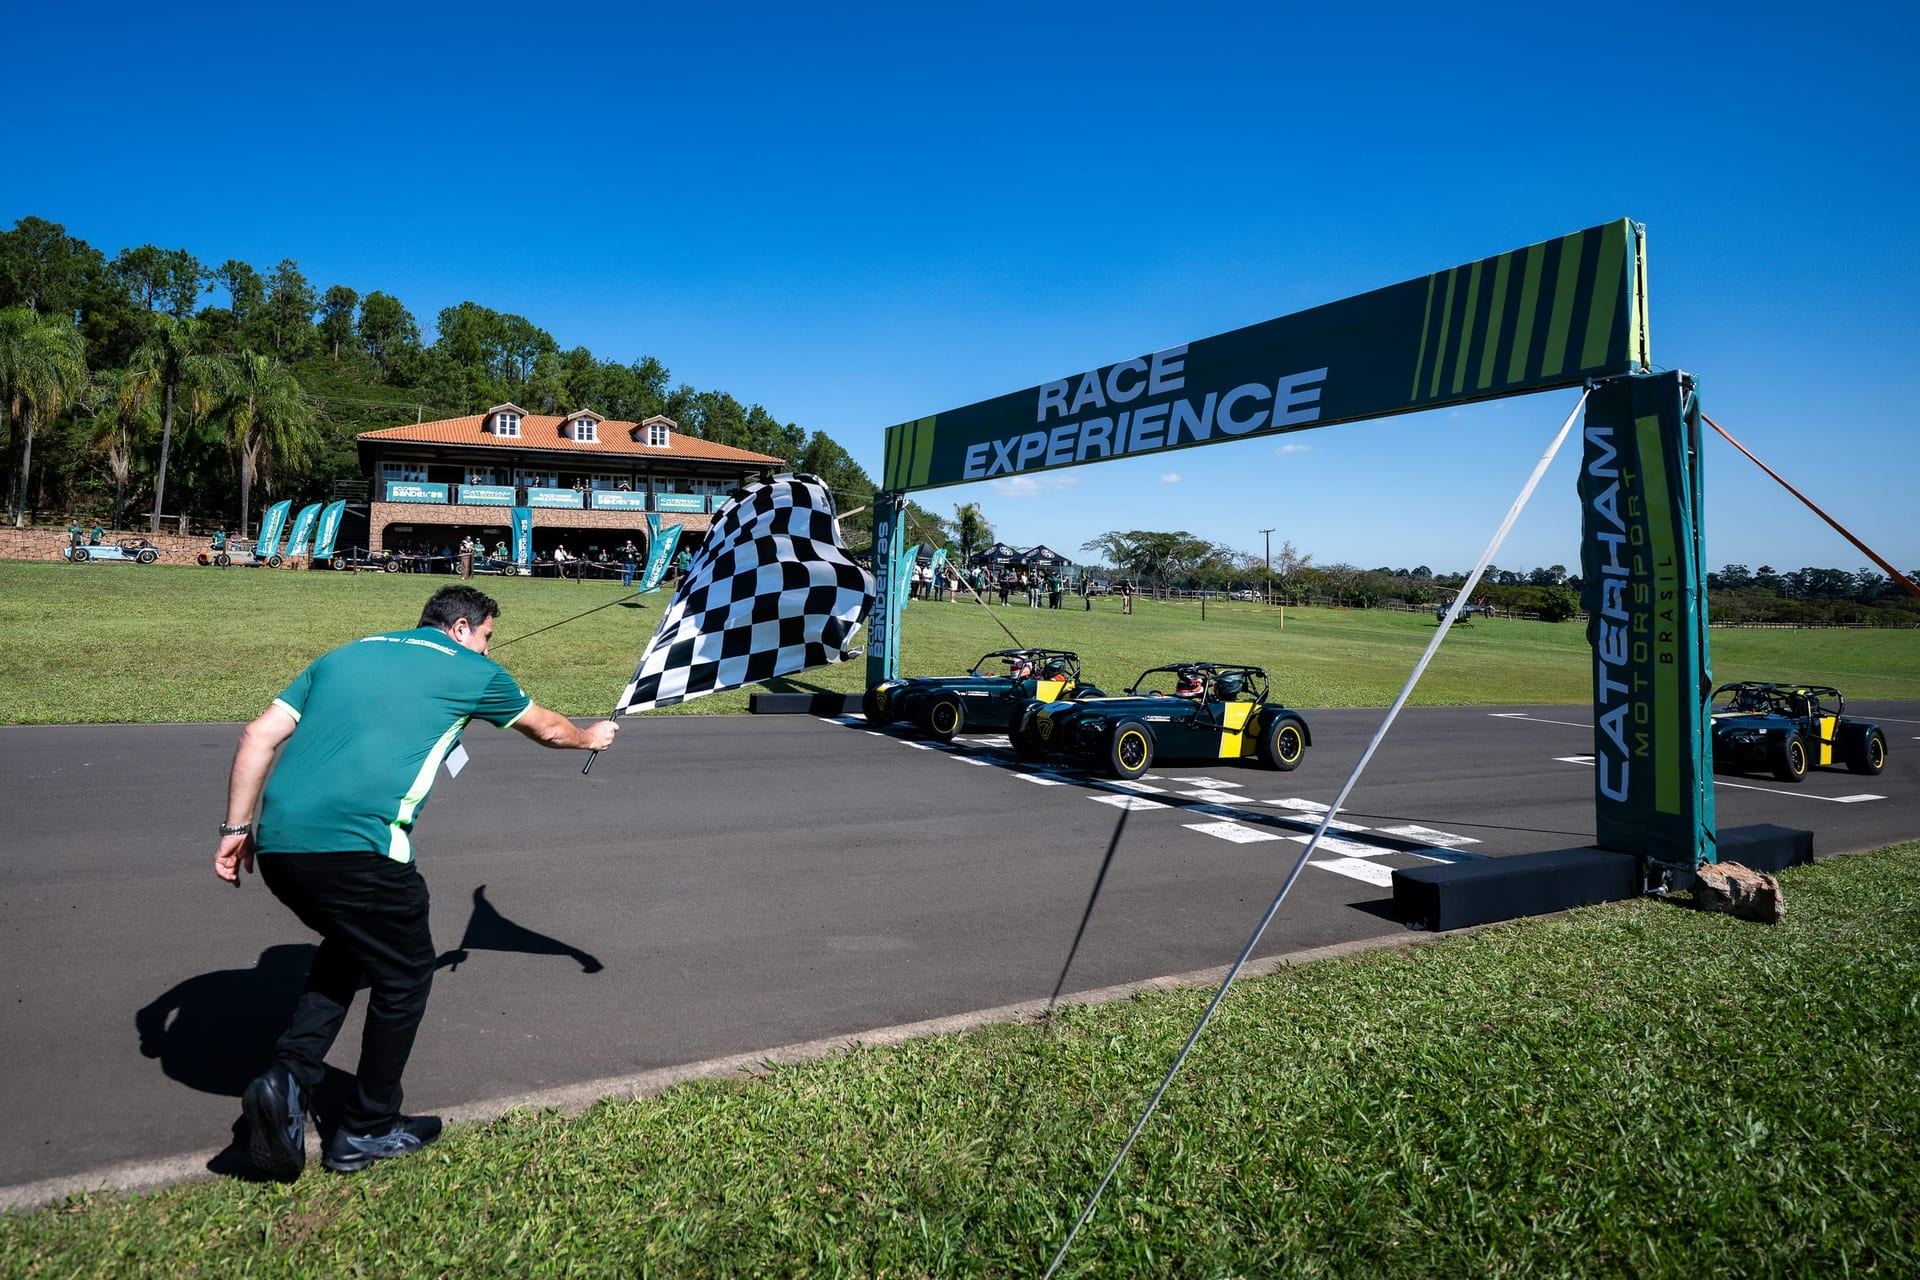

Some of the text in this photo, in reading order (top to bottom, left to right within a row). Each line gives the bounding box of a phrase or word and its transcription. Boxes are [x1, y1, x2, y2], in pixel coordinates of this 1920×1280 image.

[963, 367, 1328, 480] EXPERIENCE
[1037, 343, 1188, 422] RACE
[1585, 427, 1631, 803] CATERHAM
[1622, 467, 1649, 757] MOTORSPORT
[1659, 555, 1673, 664] BRASIL
